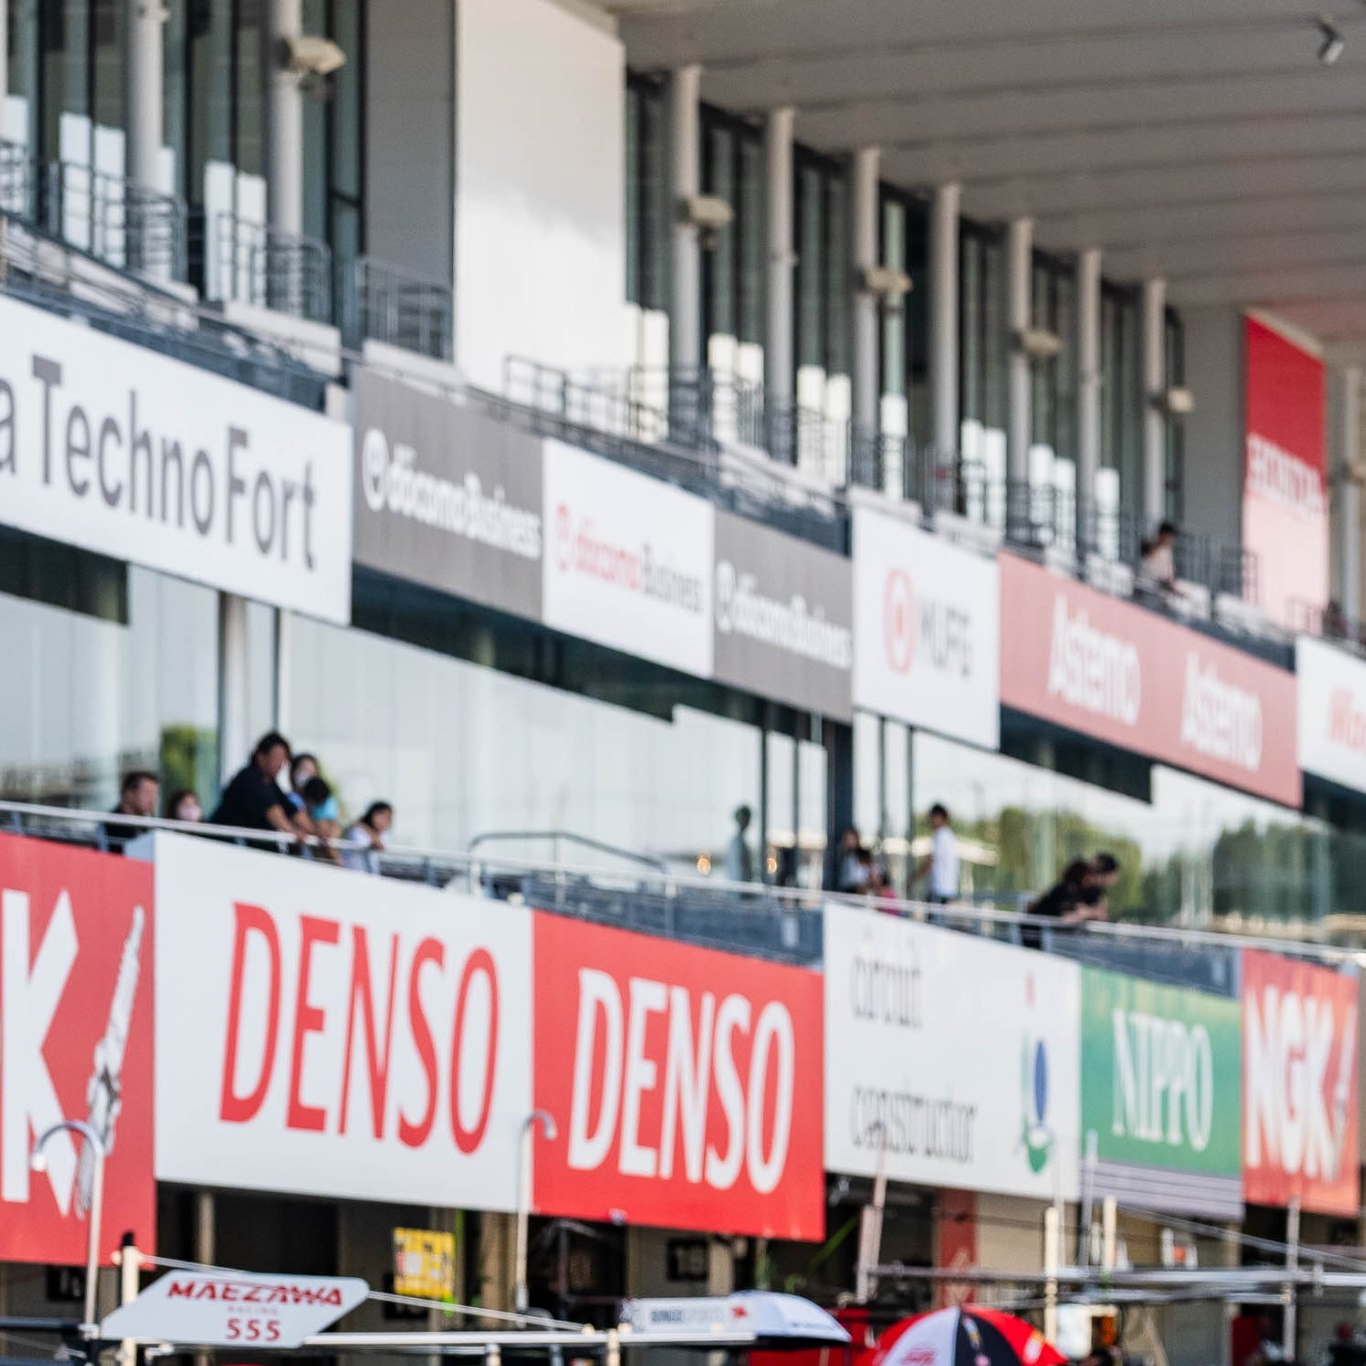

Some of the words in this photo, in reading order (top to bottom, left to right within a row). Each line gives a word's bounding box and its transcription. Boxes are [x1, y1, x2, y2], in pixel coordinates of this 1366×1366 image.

[220, 903, 498, 1154] DENSO
[568, 967, 793, 1194] DENSO
[1111, 1008, 1213, 1152] NIPPO
[1244, 983, 1337, 1182] NGK
[166, 1278, 343, 1306] MAEZAWA
[226, 1317, 281, 1341] 555
